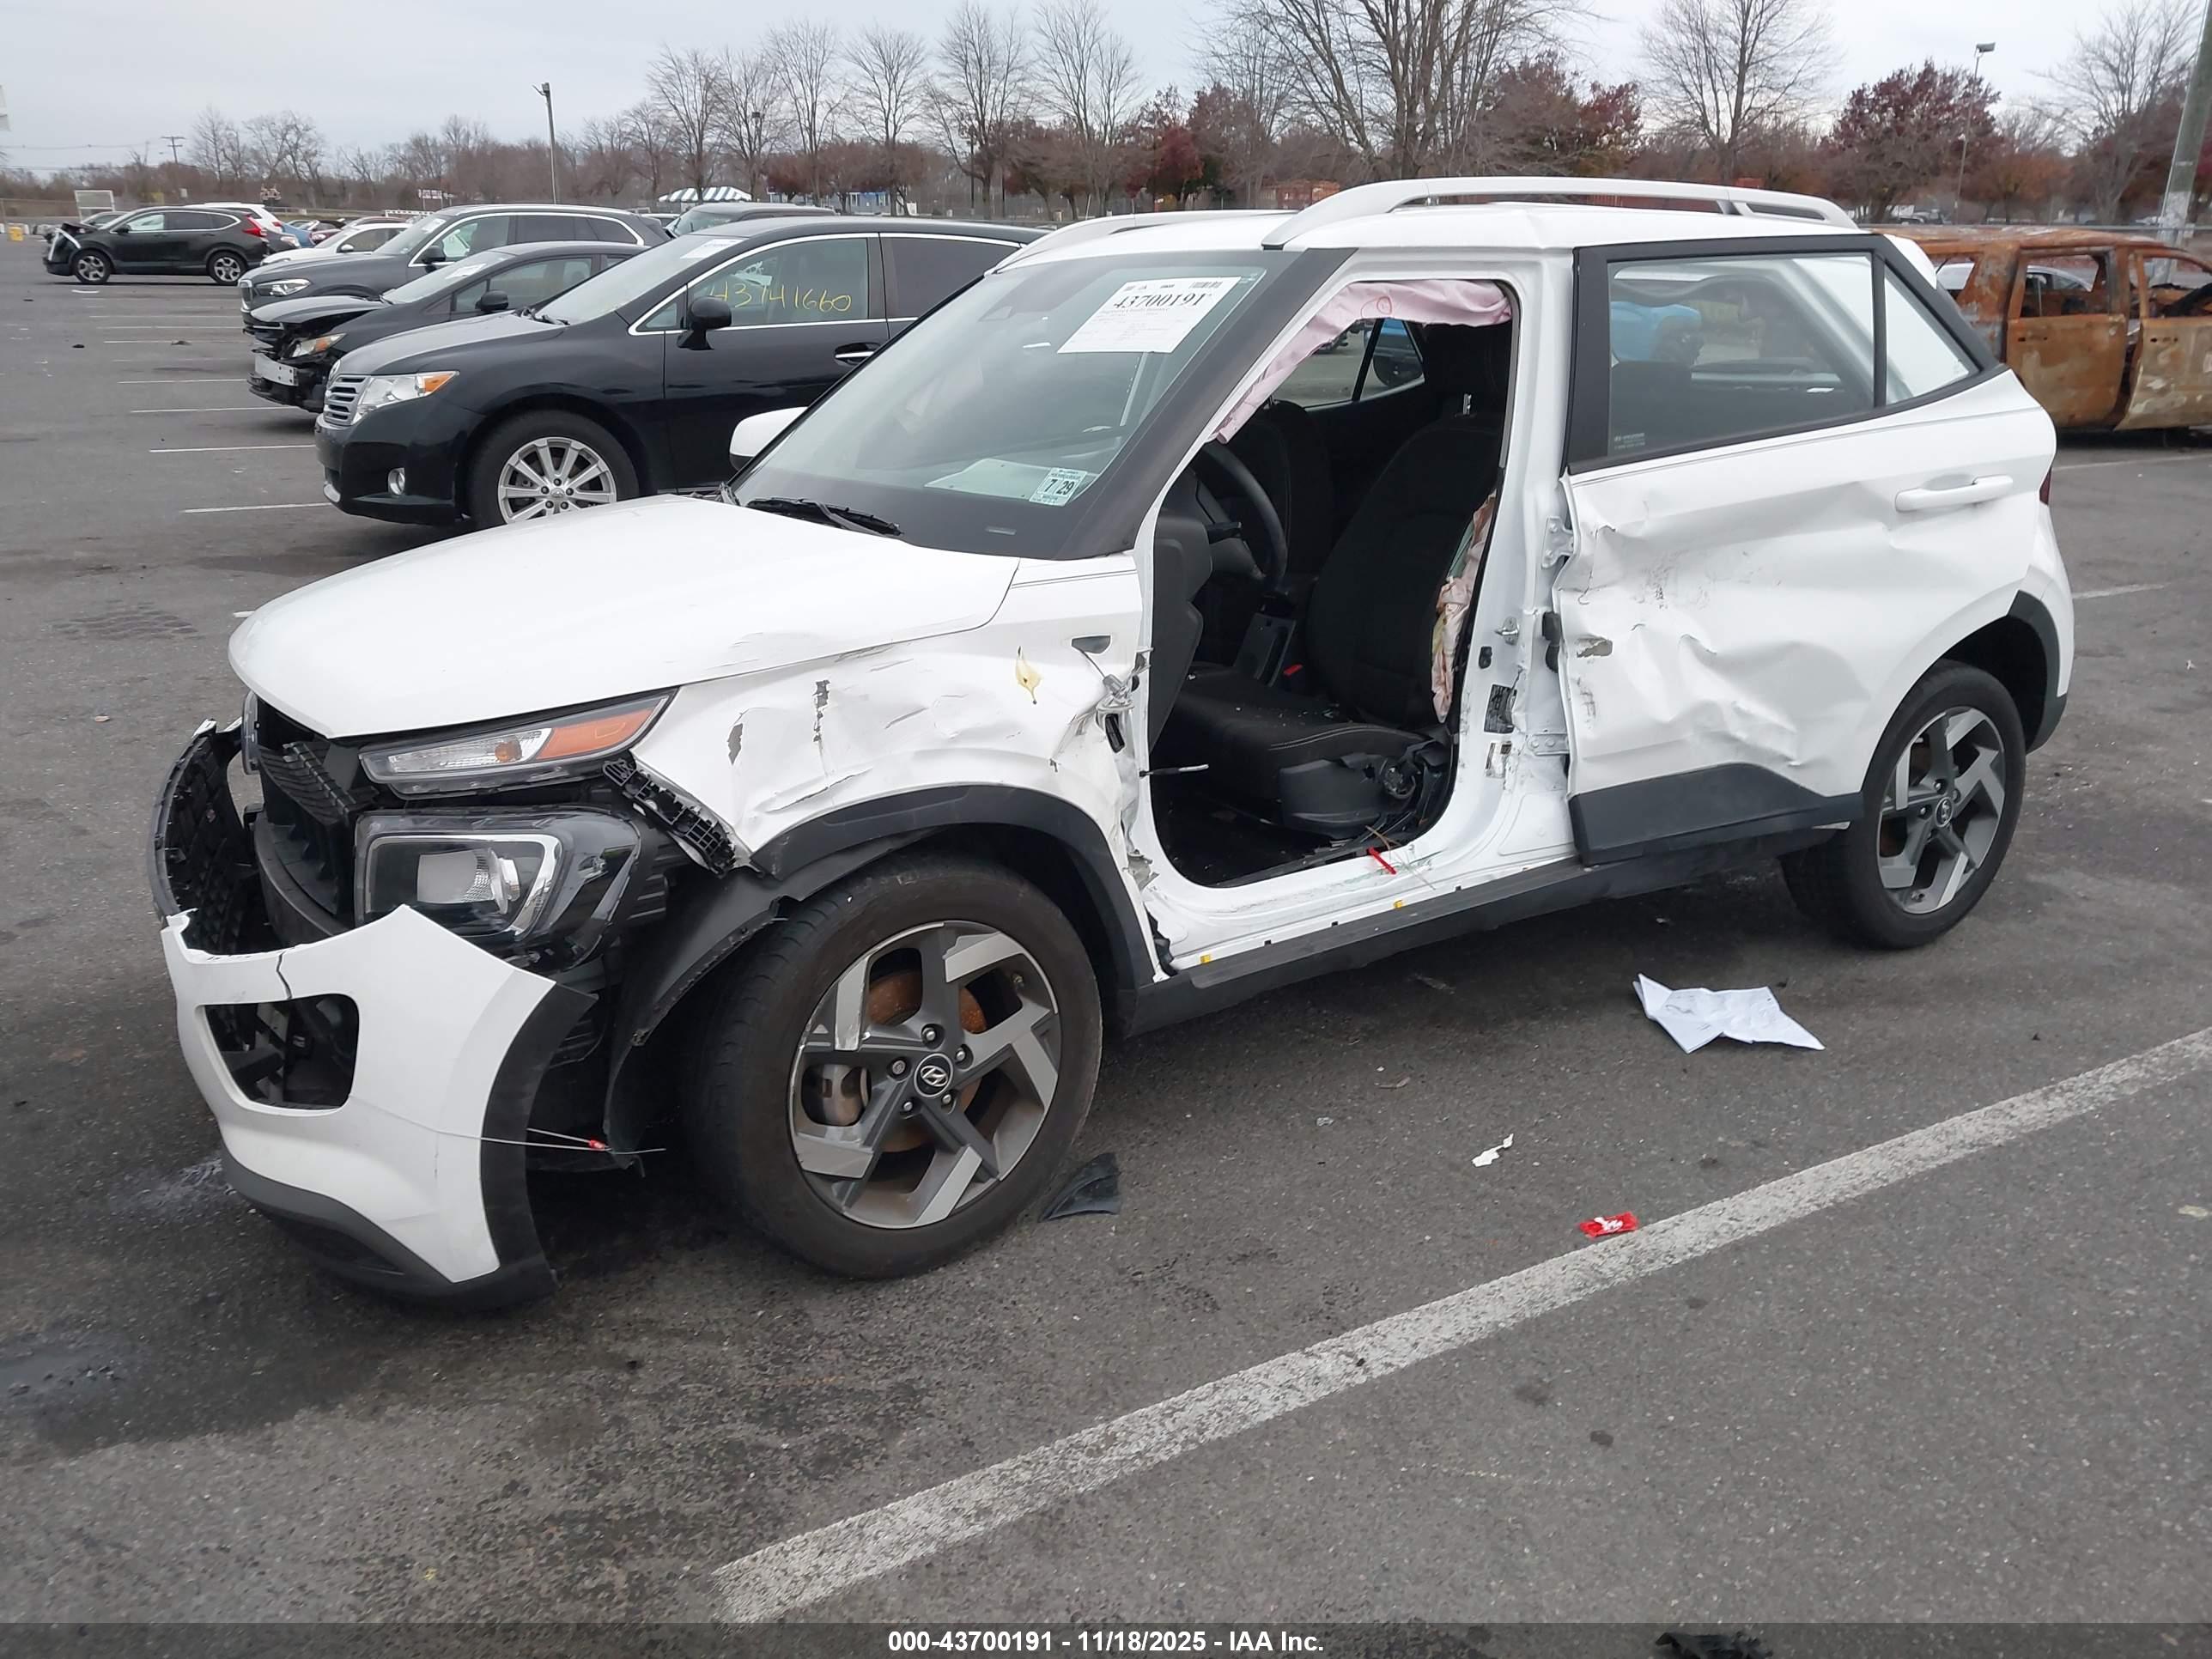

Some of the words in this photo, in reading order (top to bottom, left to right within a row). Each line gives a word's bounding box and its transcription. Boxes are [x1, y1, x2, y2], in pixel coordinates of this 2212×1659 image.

[1113, 293, 1206, 308] 43700191
[1044, 478, 1059, 493] 7
[1055, 480, 1075, 495] 29
